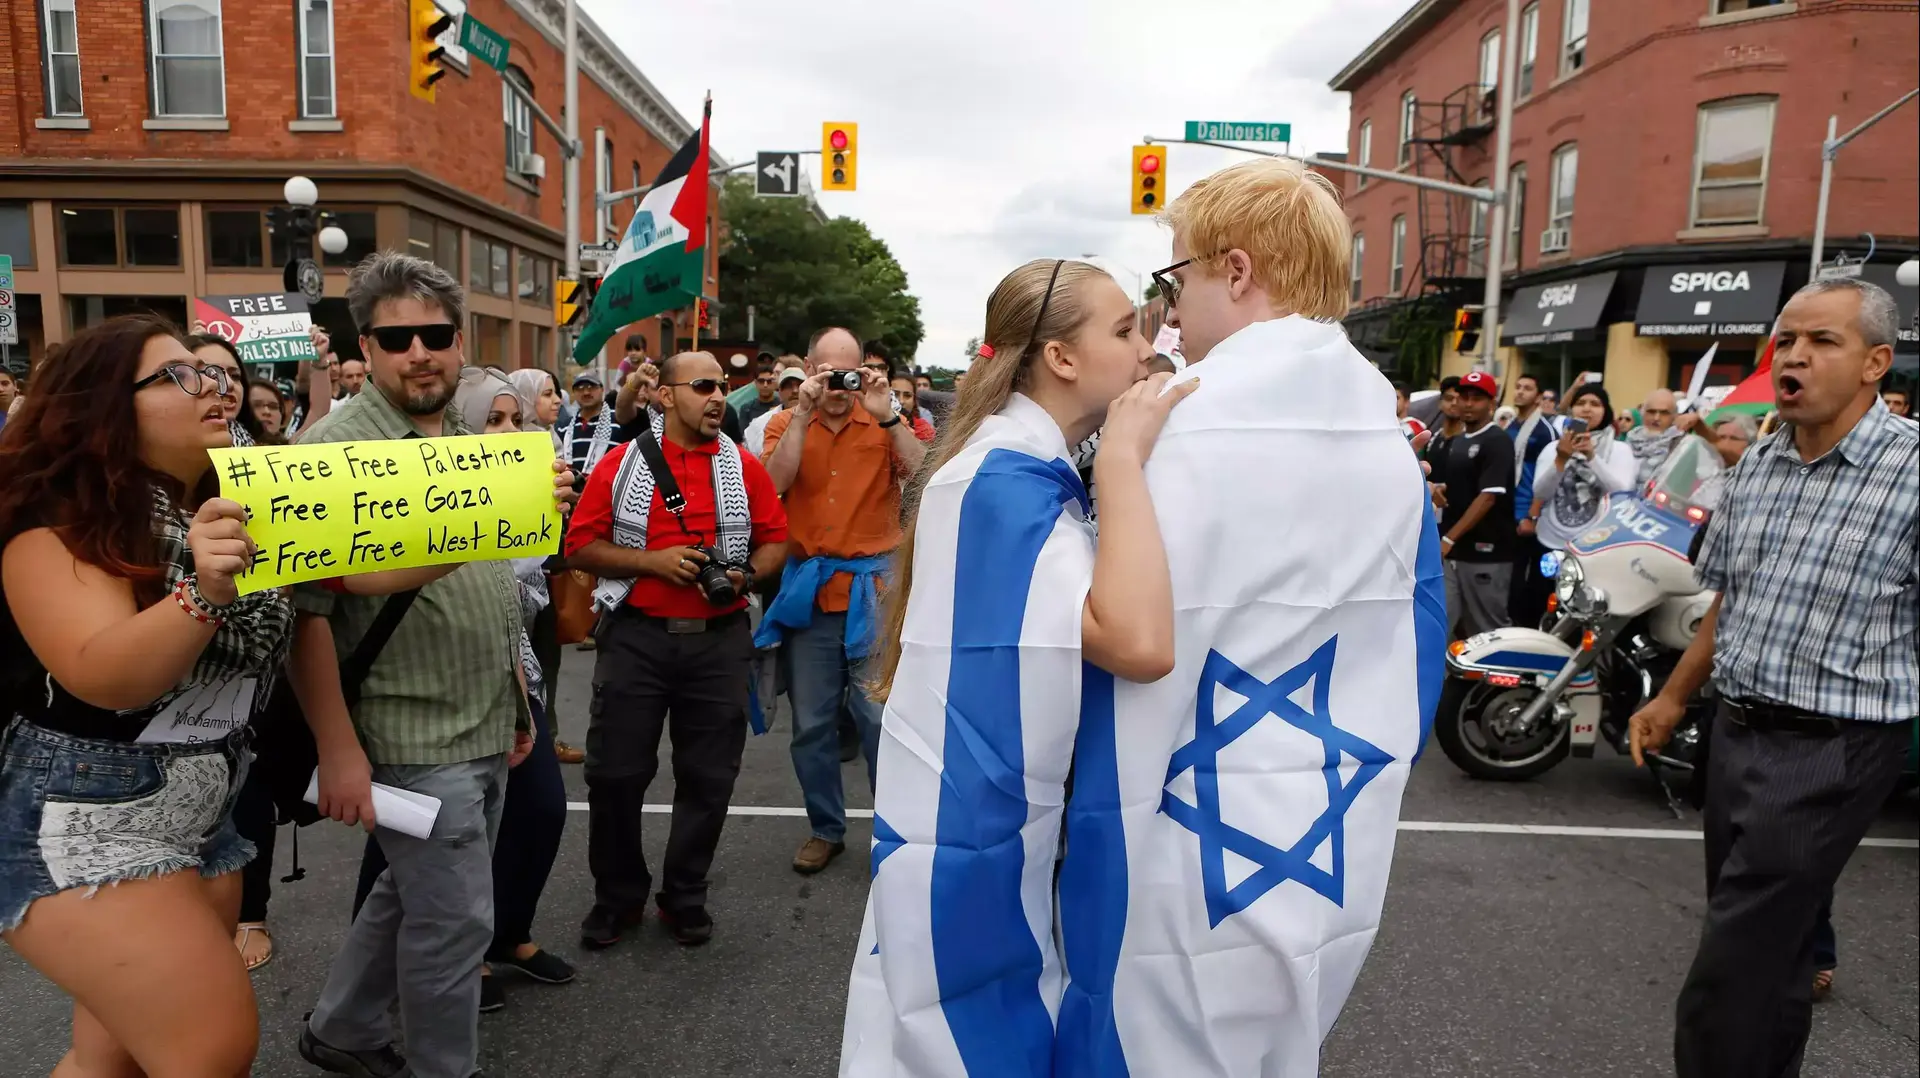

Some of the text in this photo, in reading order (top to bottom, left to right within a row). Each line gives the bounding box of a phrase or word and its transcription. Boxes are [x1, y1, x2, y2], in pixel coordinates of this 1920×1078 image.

[468, 21, 502, 68] Murray
[1198, 121, 1281, 141] Dalhousie
[1537, 283, 1578, 309] SPIGA
[1669, 270, 1750, 293] SPIGA
[228, 295, 287, 314] FREE
[1640, 323, 1766, 335] RESTAURANT LOUNGE
[228, 442, 525, 487] # Free Free Palestine
[271, 494, 328, 525] Free
[354, 491, 409, 525] Free
[425, 485, 493, 513] Gaza
[1612, 498, 1670, 540] POLICE
[276, 540, 337, 576] Free
[348, 530, 405, 566] Free
[428, 520, 487, 554] West
[497, 513, 552, 549] Bank
